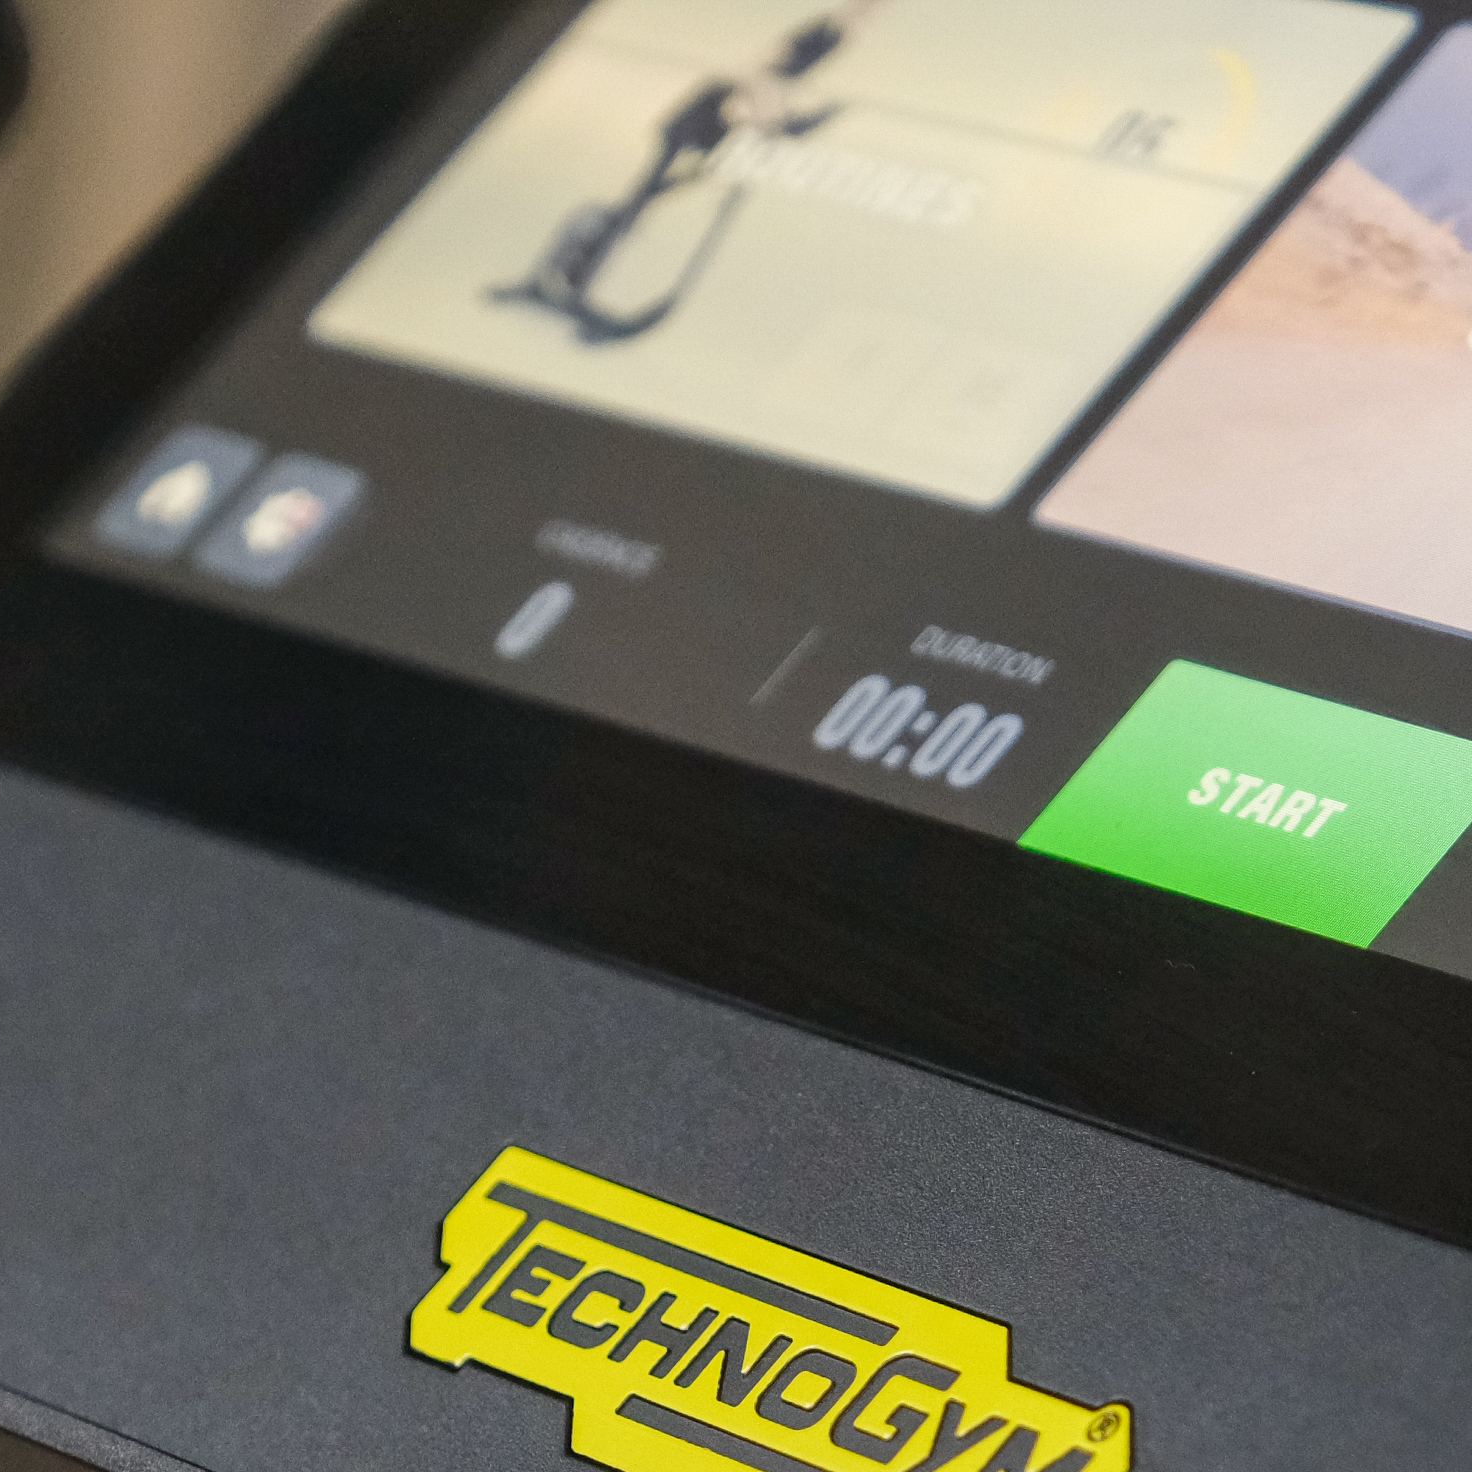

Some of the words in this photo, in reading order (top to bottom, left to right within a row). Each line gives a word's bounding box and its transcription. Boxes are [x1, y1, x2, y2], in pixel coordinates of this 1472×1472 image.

[910, 624, 1057, 686] DURATION
[813, 673, 1025, 789] 00:00
[1187, 766, 1349, 839] START
